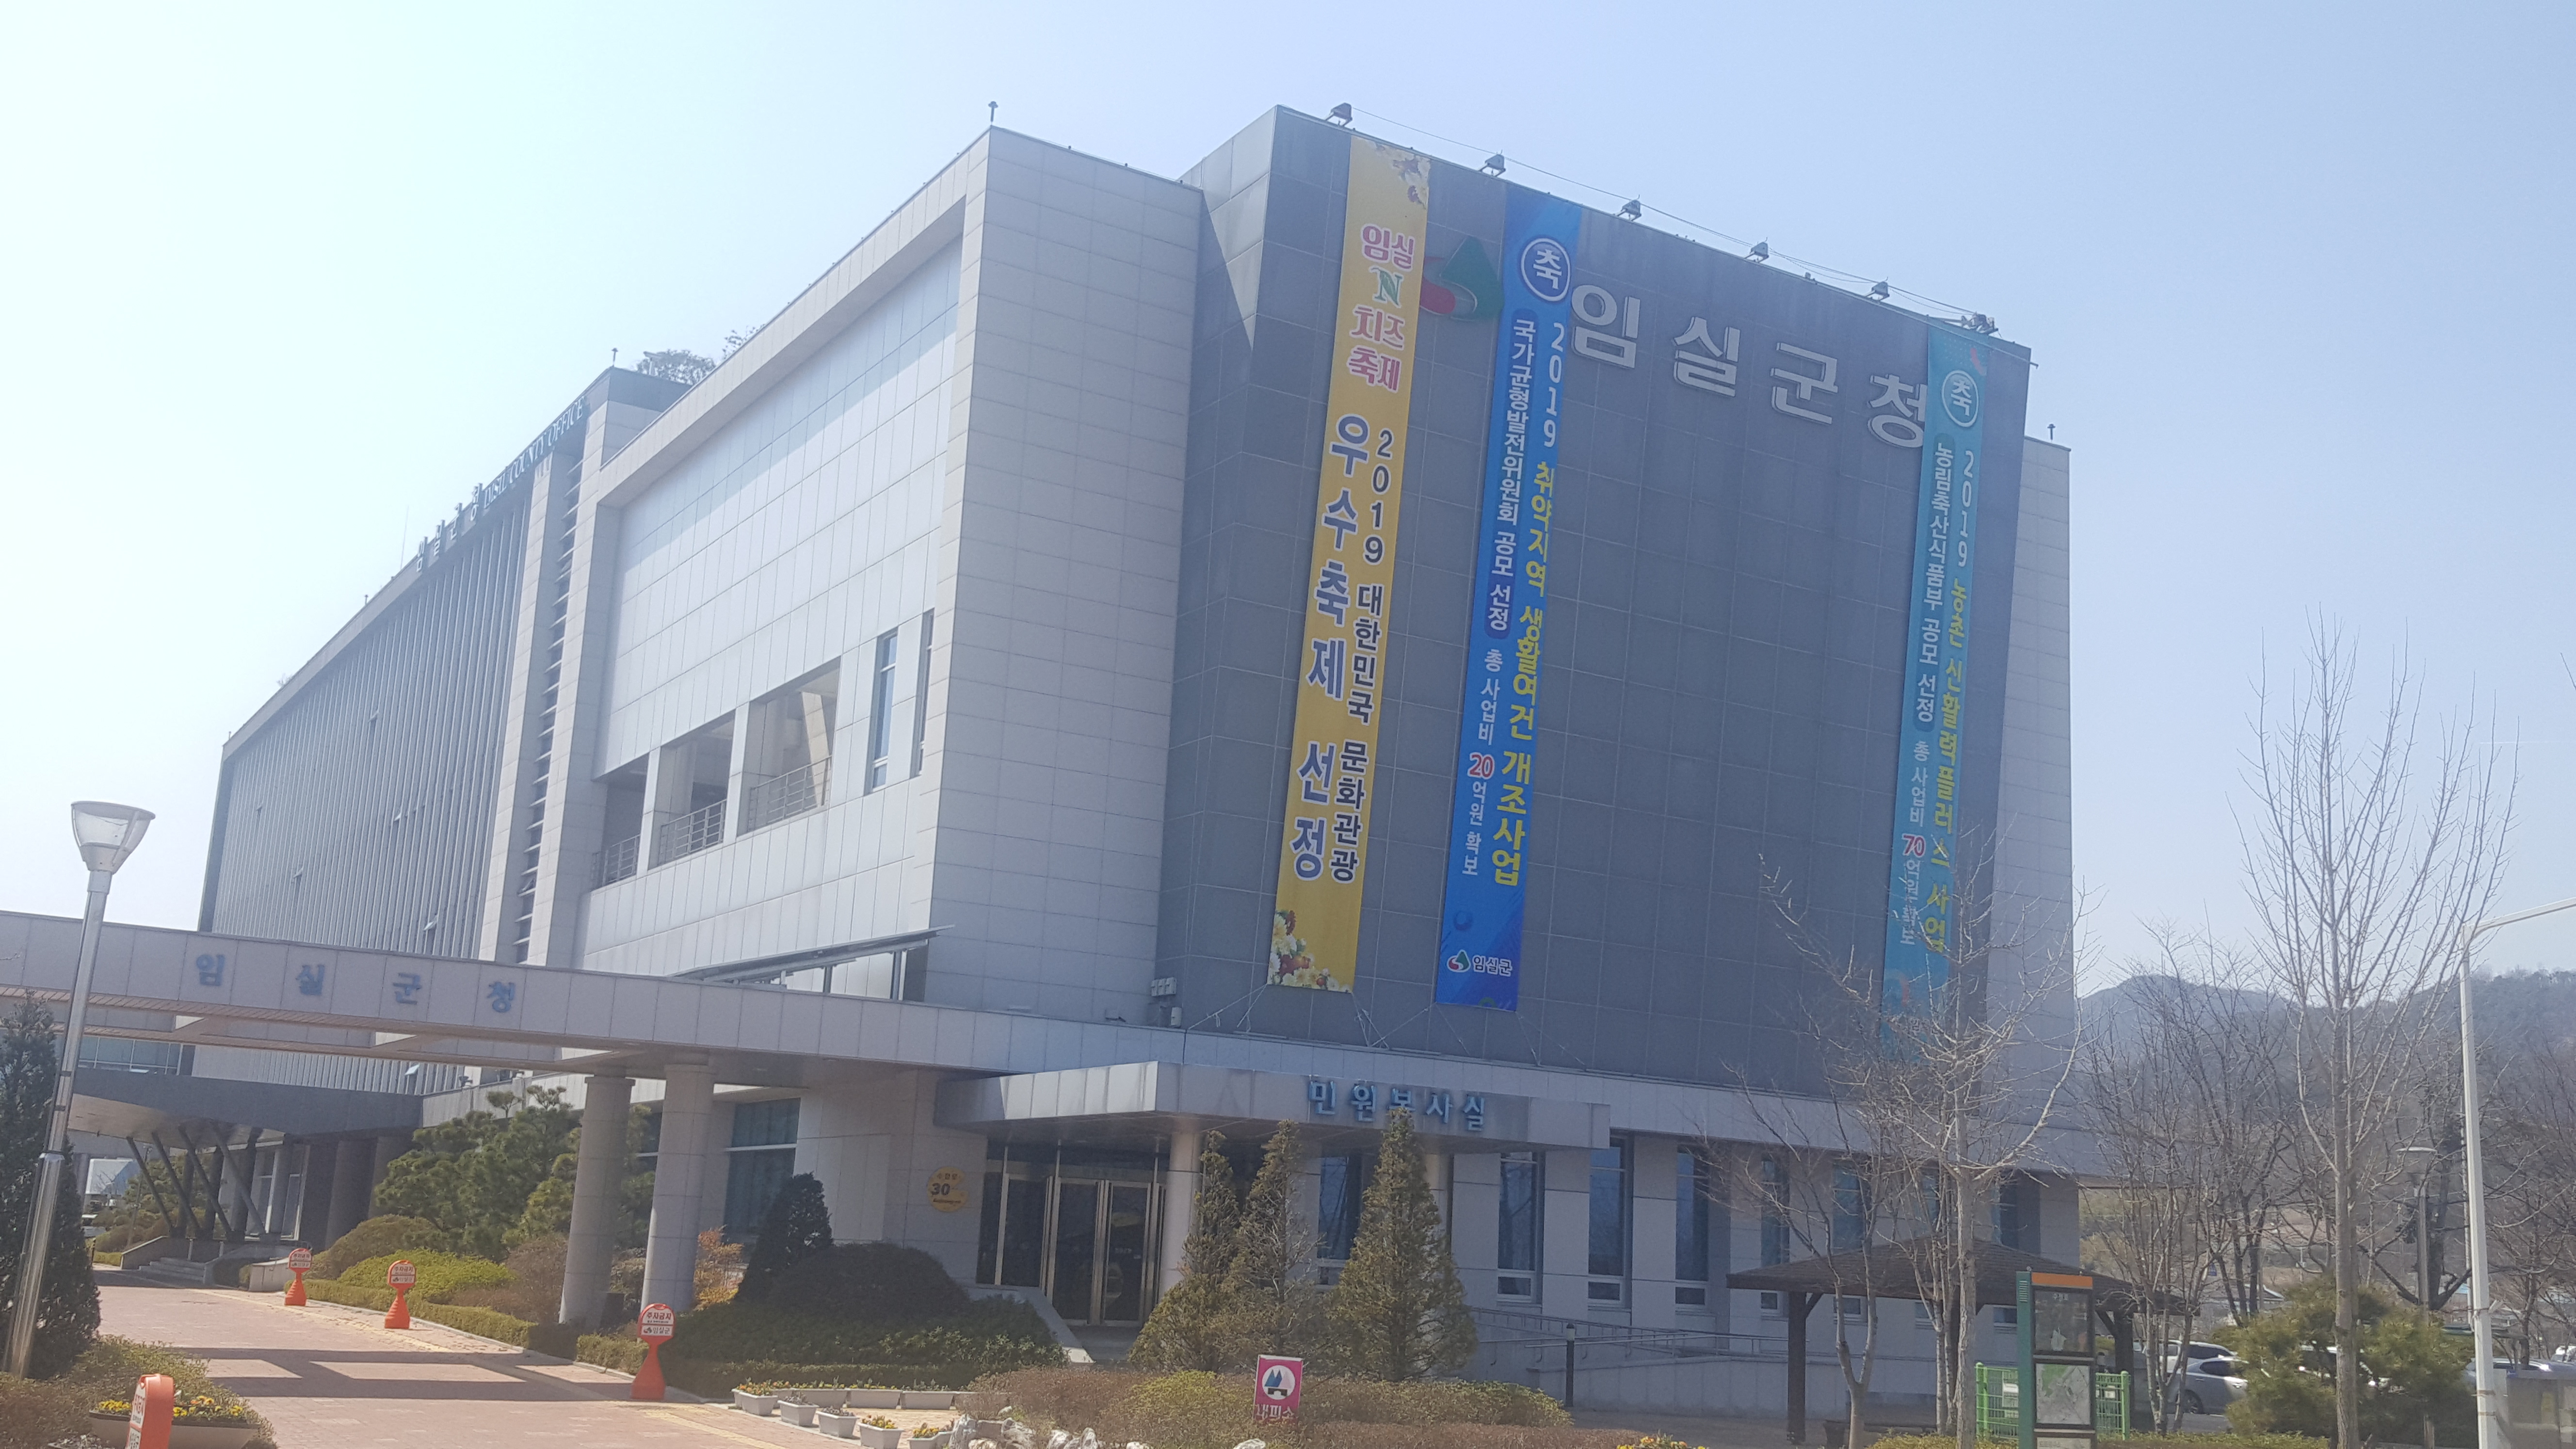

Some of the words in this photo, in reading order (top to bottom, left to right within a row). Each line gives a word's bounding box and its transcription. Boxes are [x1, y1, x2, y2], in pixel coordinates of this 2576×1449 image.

[1362, 225, 1414, 269] 임실
[1532, 248, 1563, 290] 축
[1371, 268, 1402, 306] N
[1351, 307, 1404, 348] 치즈
[1348, 348, 1400, 390] 축제
[1544, 323, 1565, 447] 2019
[1571, 285, 1927, 449] 임실군청
[1950, 379, 1972, 417] 축
[1497, 319, 1536, 526] 국가균형발전위원회
[1365, 430, 1393, 563] 2019
[1958, 451, 1974, 567] 2019
[416, 484, 480, 572] 임실군청
[1923, 443, 1953, 611] 농림축산식품부
[1492, 531, 1516, 577] 공모
[1488, 585, 1511, 631] 선정
[1348, 585, 1383, 723] 대한민국
[1484, 649, 1503, 672] 총
[1919, 618, 1940, 665] 공모
[1478, 678, 1500, 745] 사업비
[1916, 674, 1935, 722] 선정
[1914, 741, 1930, 761] 총
[1291, 742, 1335, 880] 선정
[1332, 741, 1368, 882] 문화관광
[1492, 751, 1531, 886] 개조사업
[1910, 767, 1928, 827] 사업비
[1462, 831, 1481, 875] 확보
[196, 953, 515, 1013] 임실군청
[1473, 955, 1512, 976] 임실군
[931, 1183, 950, 1195] 30
